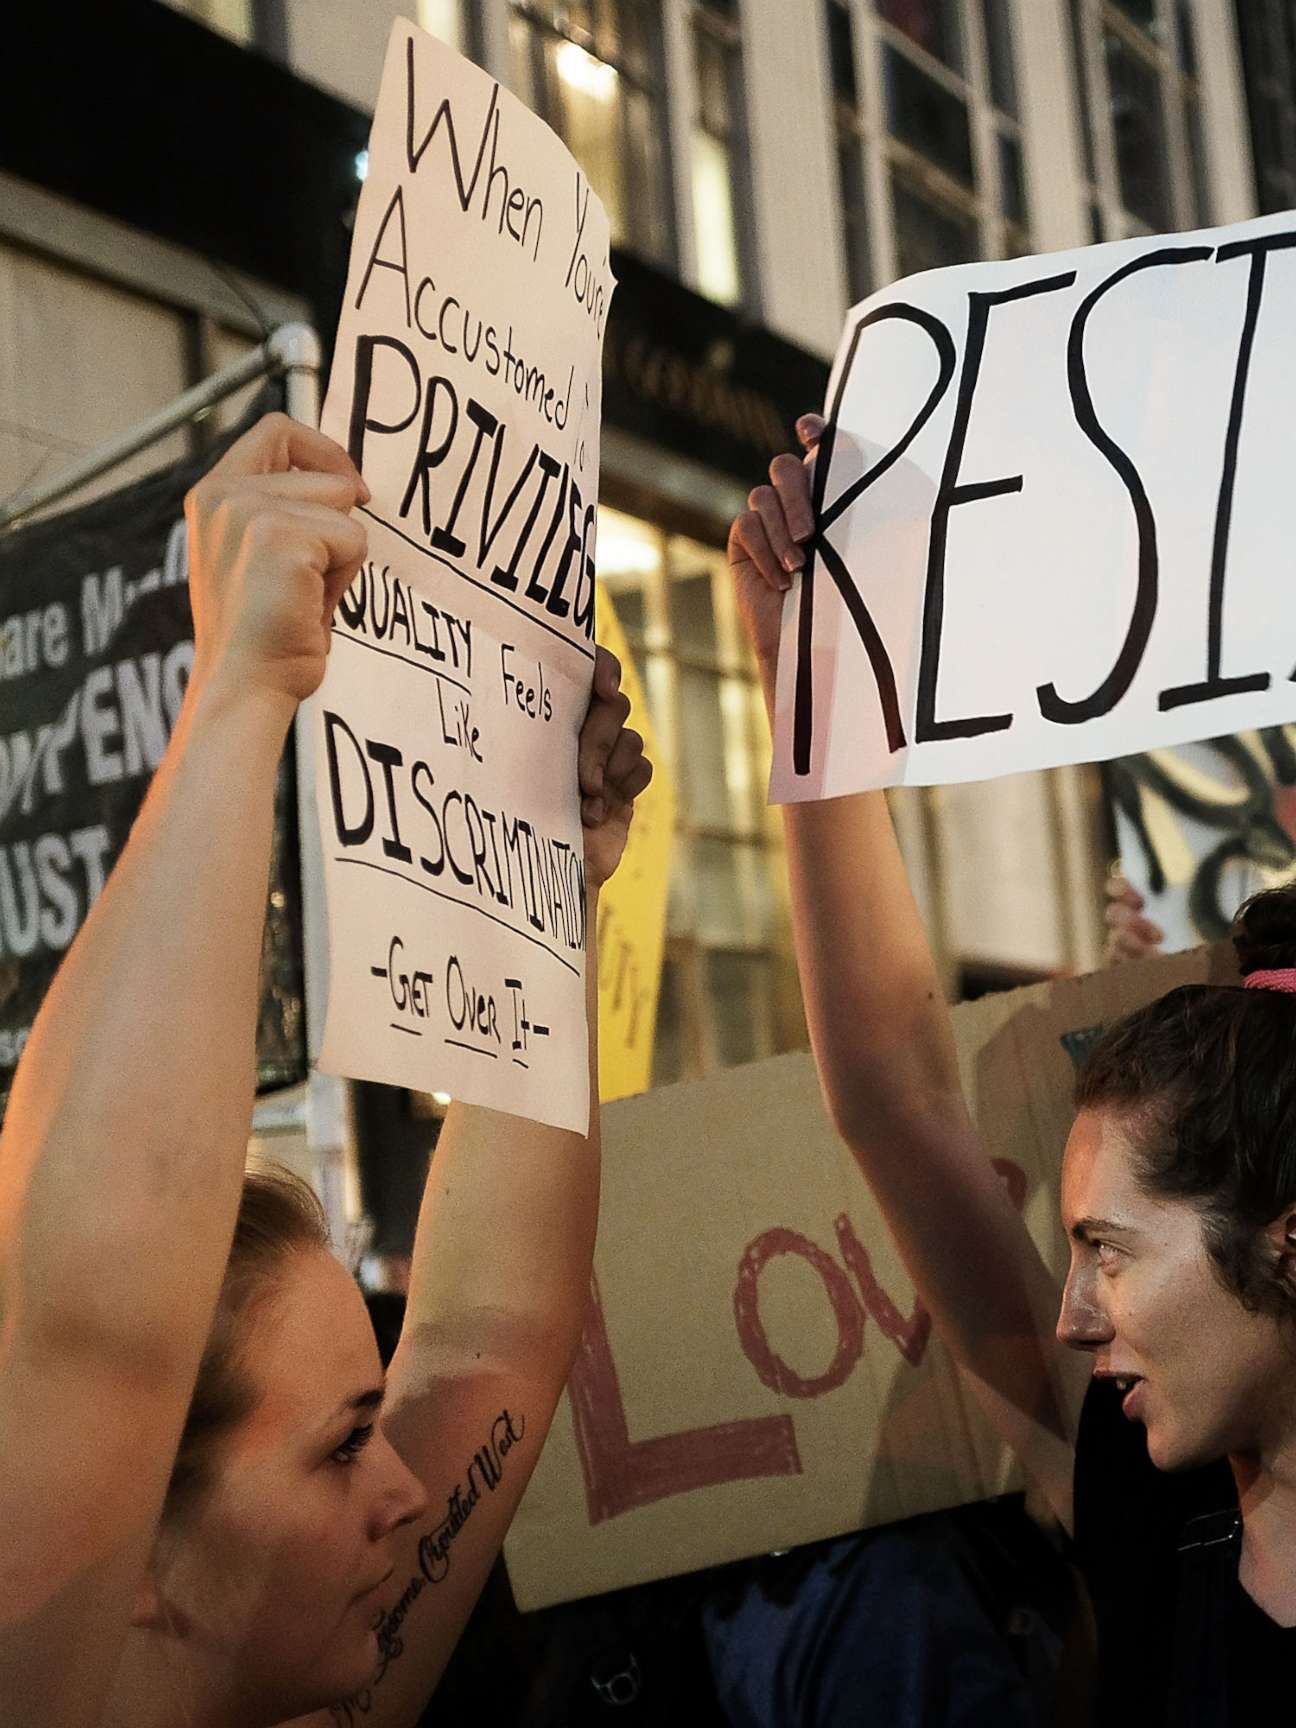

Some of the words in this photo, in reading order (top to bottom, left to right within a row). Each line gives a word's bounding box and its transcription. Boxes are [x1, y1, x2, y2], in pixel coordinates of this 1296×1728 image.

[407, 36, 543, 263] When
[355, 184, 575, 431] Accustomed
[347, 334, 596, 641] PRIVILEG
[331, 560, 472, 679] QUALITY
[501, 643, 553, 722] Feels
